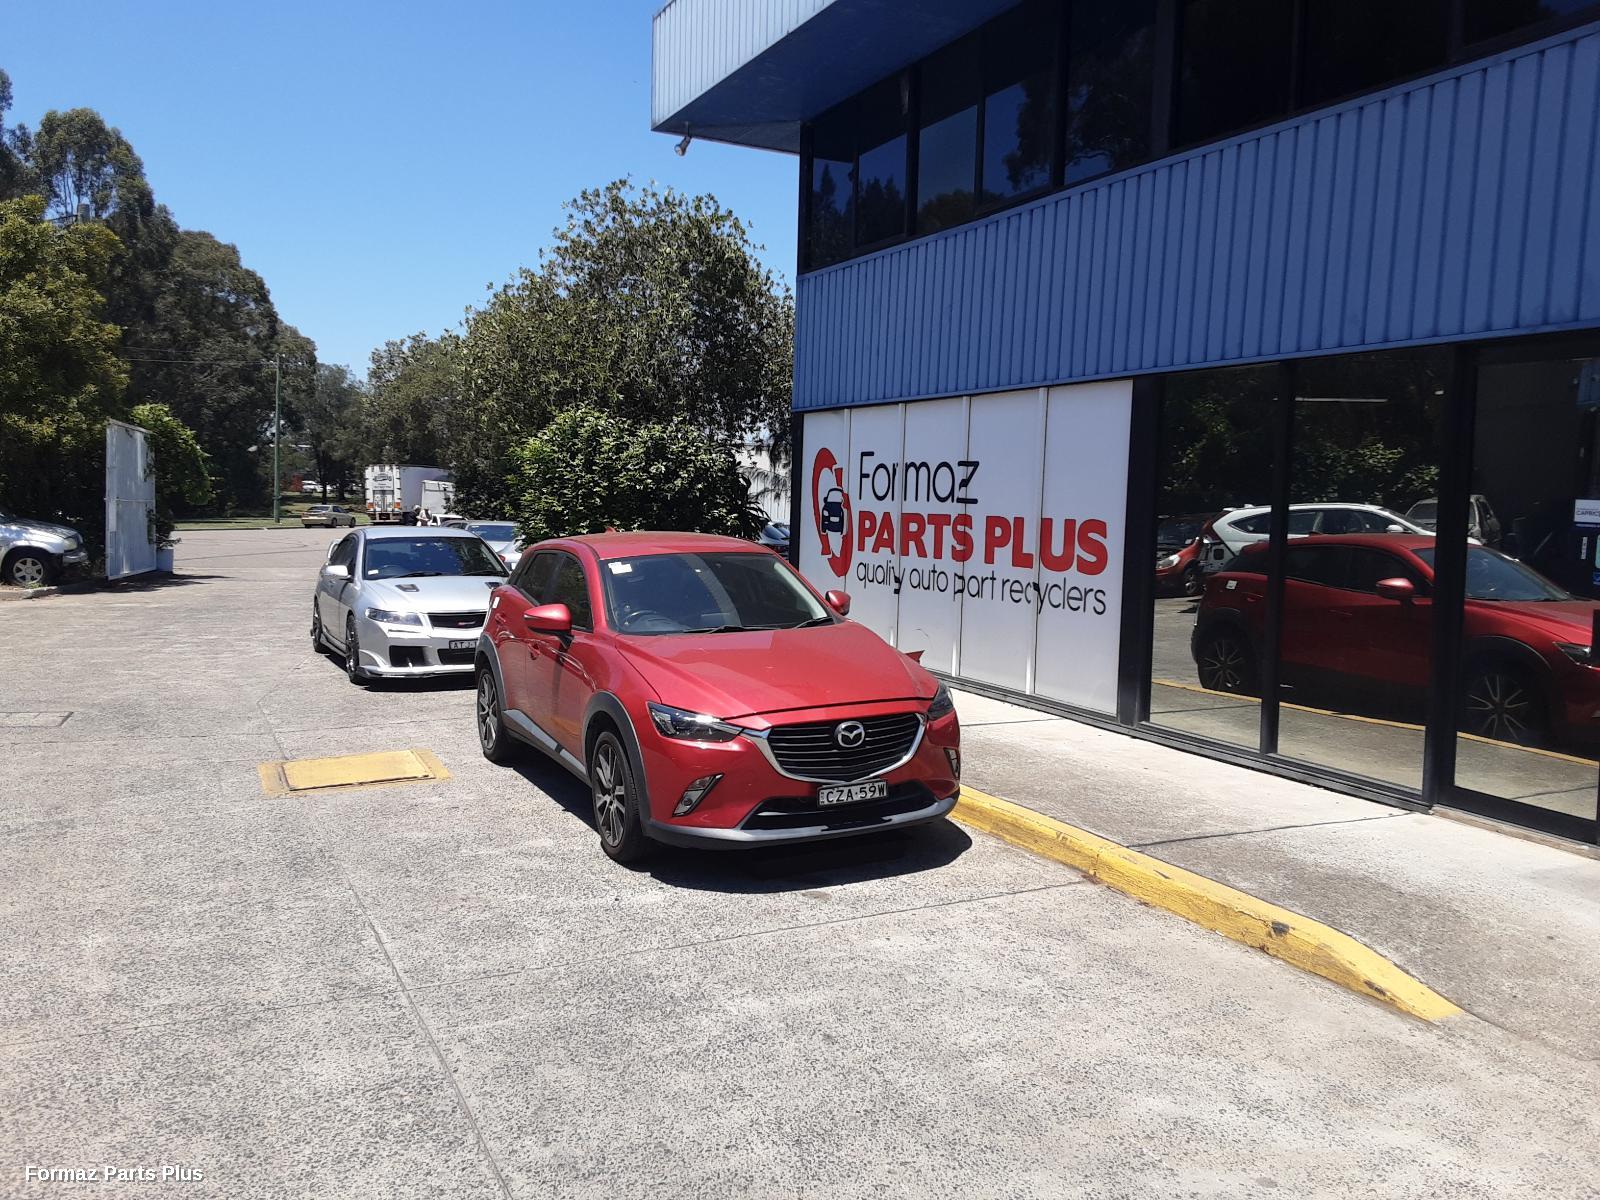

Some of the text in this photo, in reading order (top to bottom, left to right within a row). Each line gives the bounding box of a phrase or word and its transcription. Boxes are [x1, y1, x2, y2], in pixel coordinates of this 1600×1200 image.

[858, 451, 980, 504] Formaz
[857, 510, 1109, 575] PARTS PLUS
[856, 560, 1107, 615] qualiy auto part recyclers
